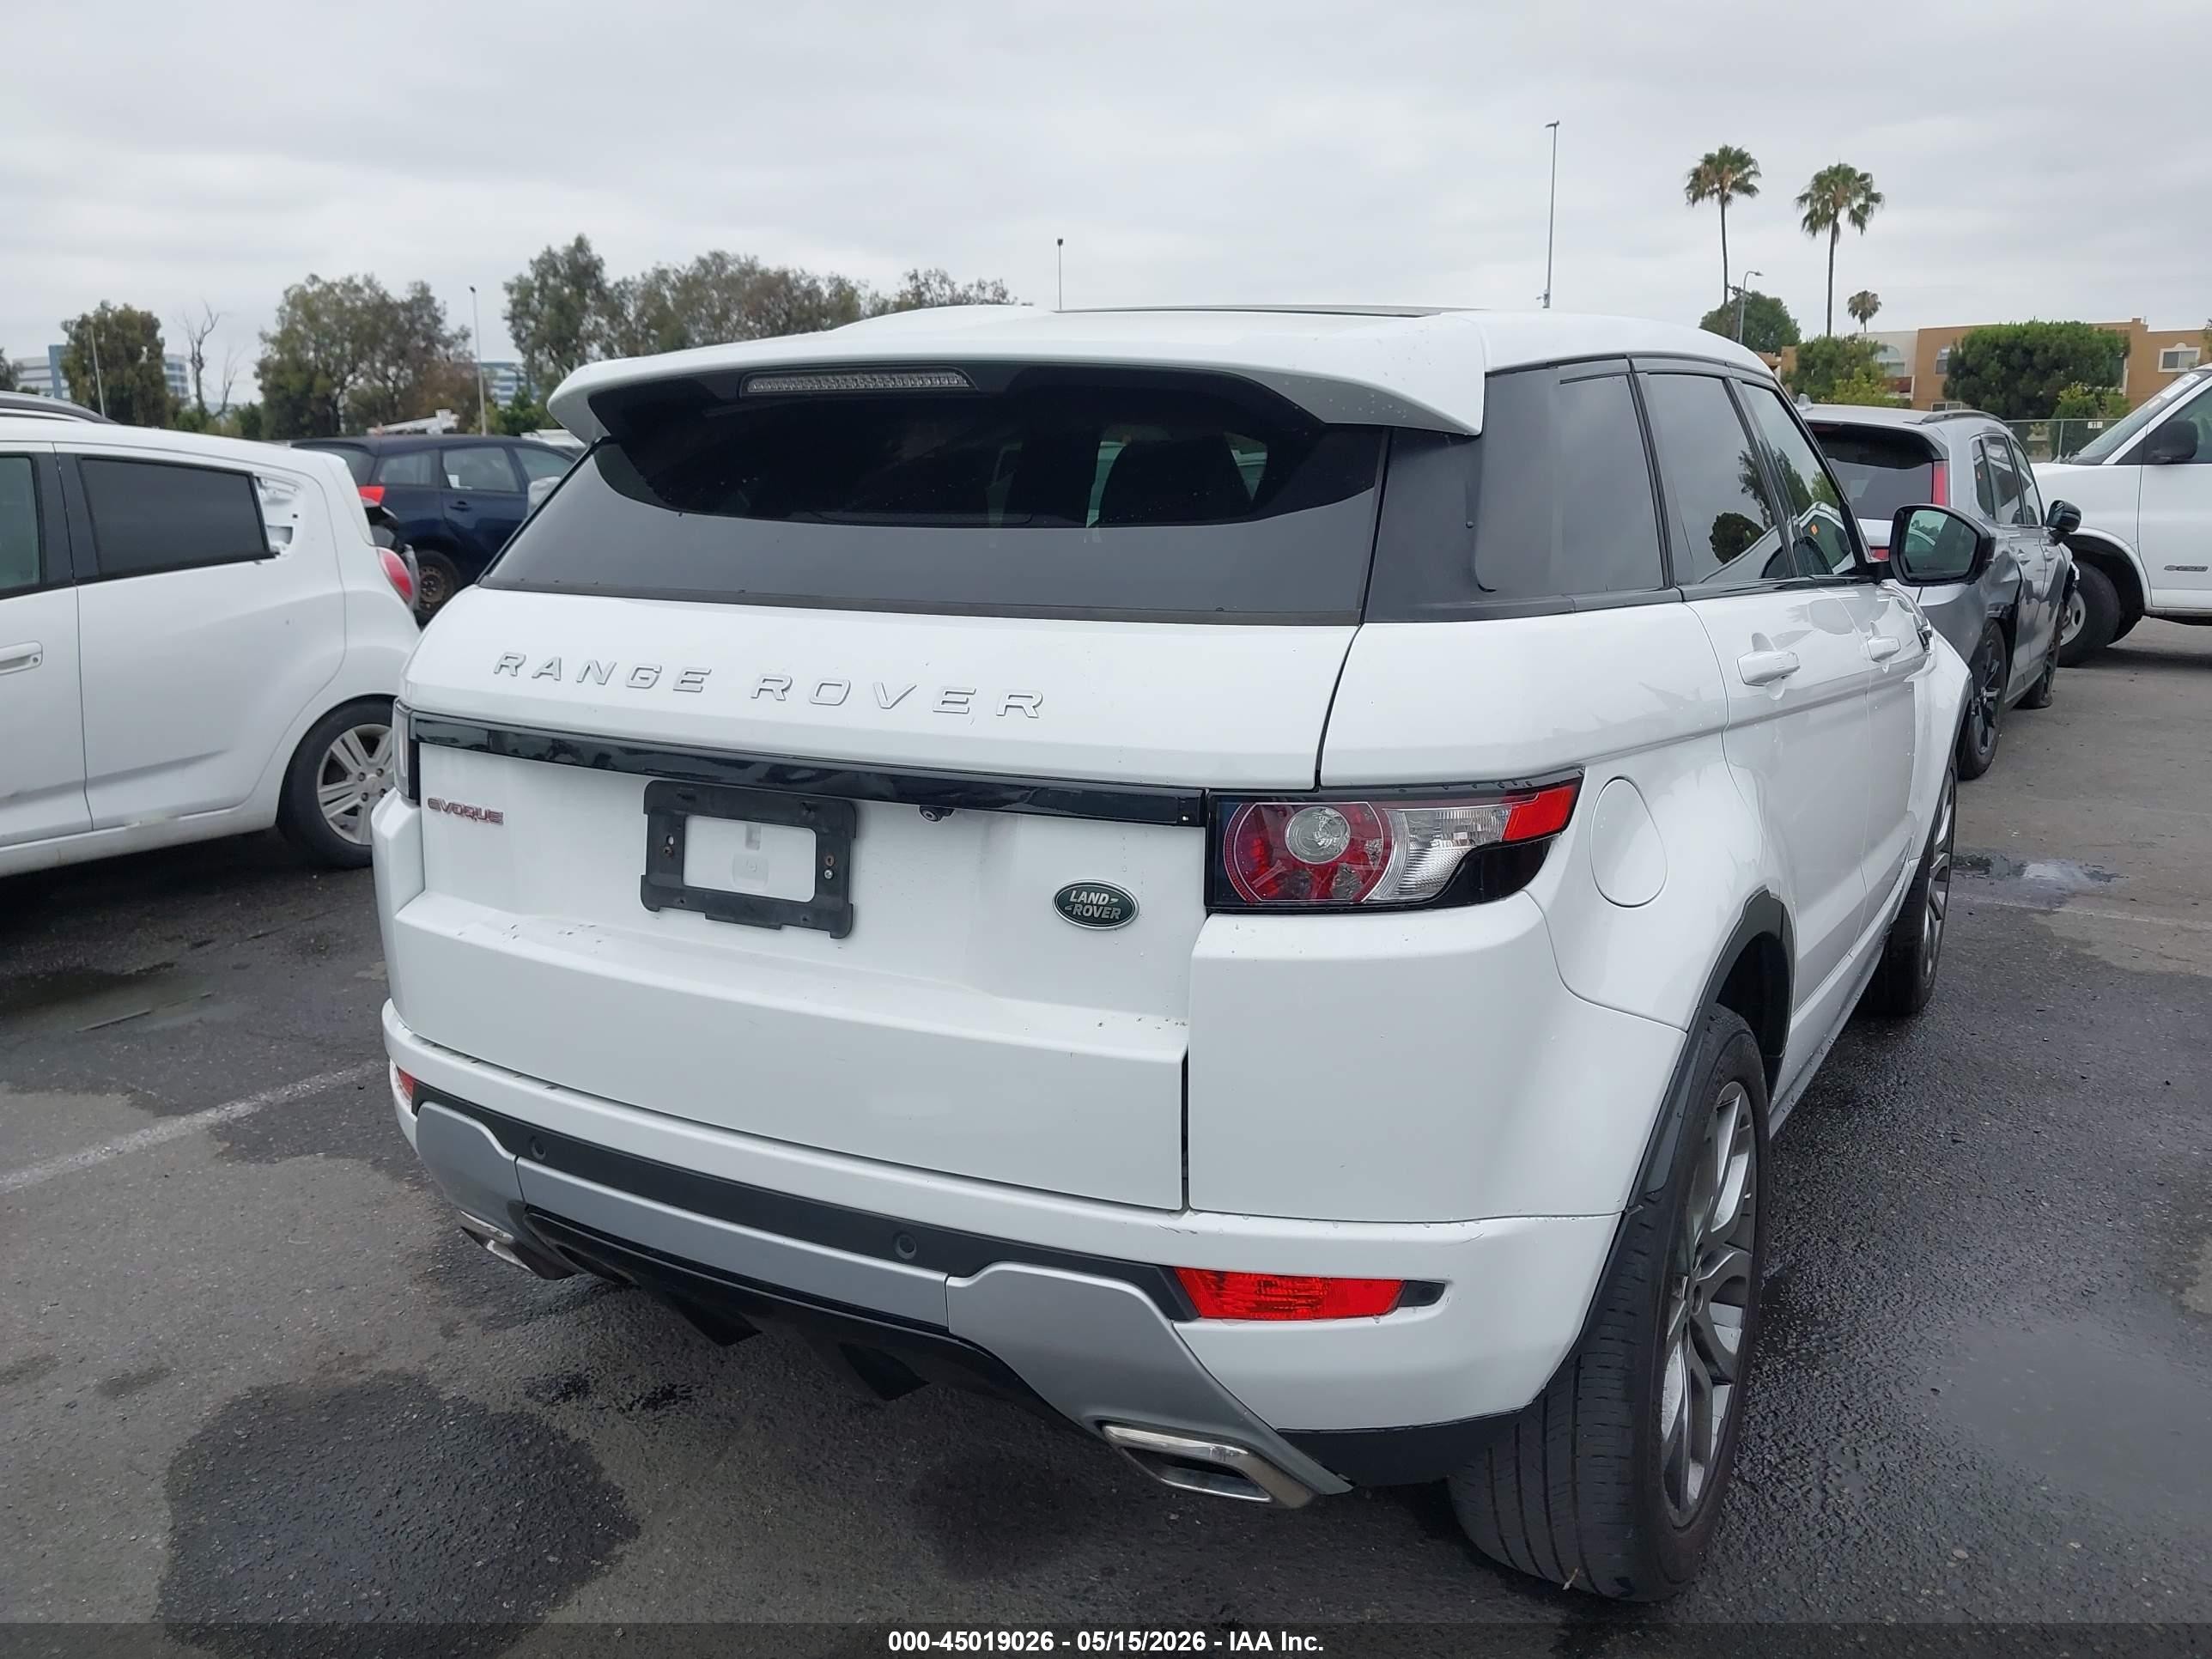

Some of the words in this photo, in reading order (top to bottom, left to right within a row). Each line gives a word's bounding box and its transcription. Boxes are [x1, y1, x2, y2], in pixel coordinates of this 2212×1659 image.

[493, 651, 712, 693] RANGE
[750, 672, 1043, 719] ROVER
[427, 797, 504, 825] EVOQUE
[1069, 890, 1110, 906] LAND
[1072, 903, 1122, 921] ROVER
